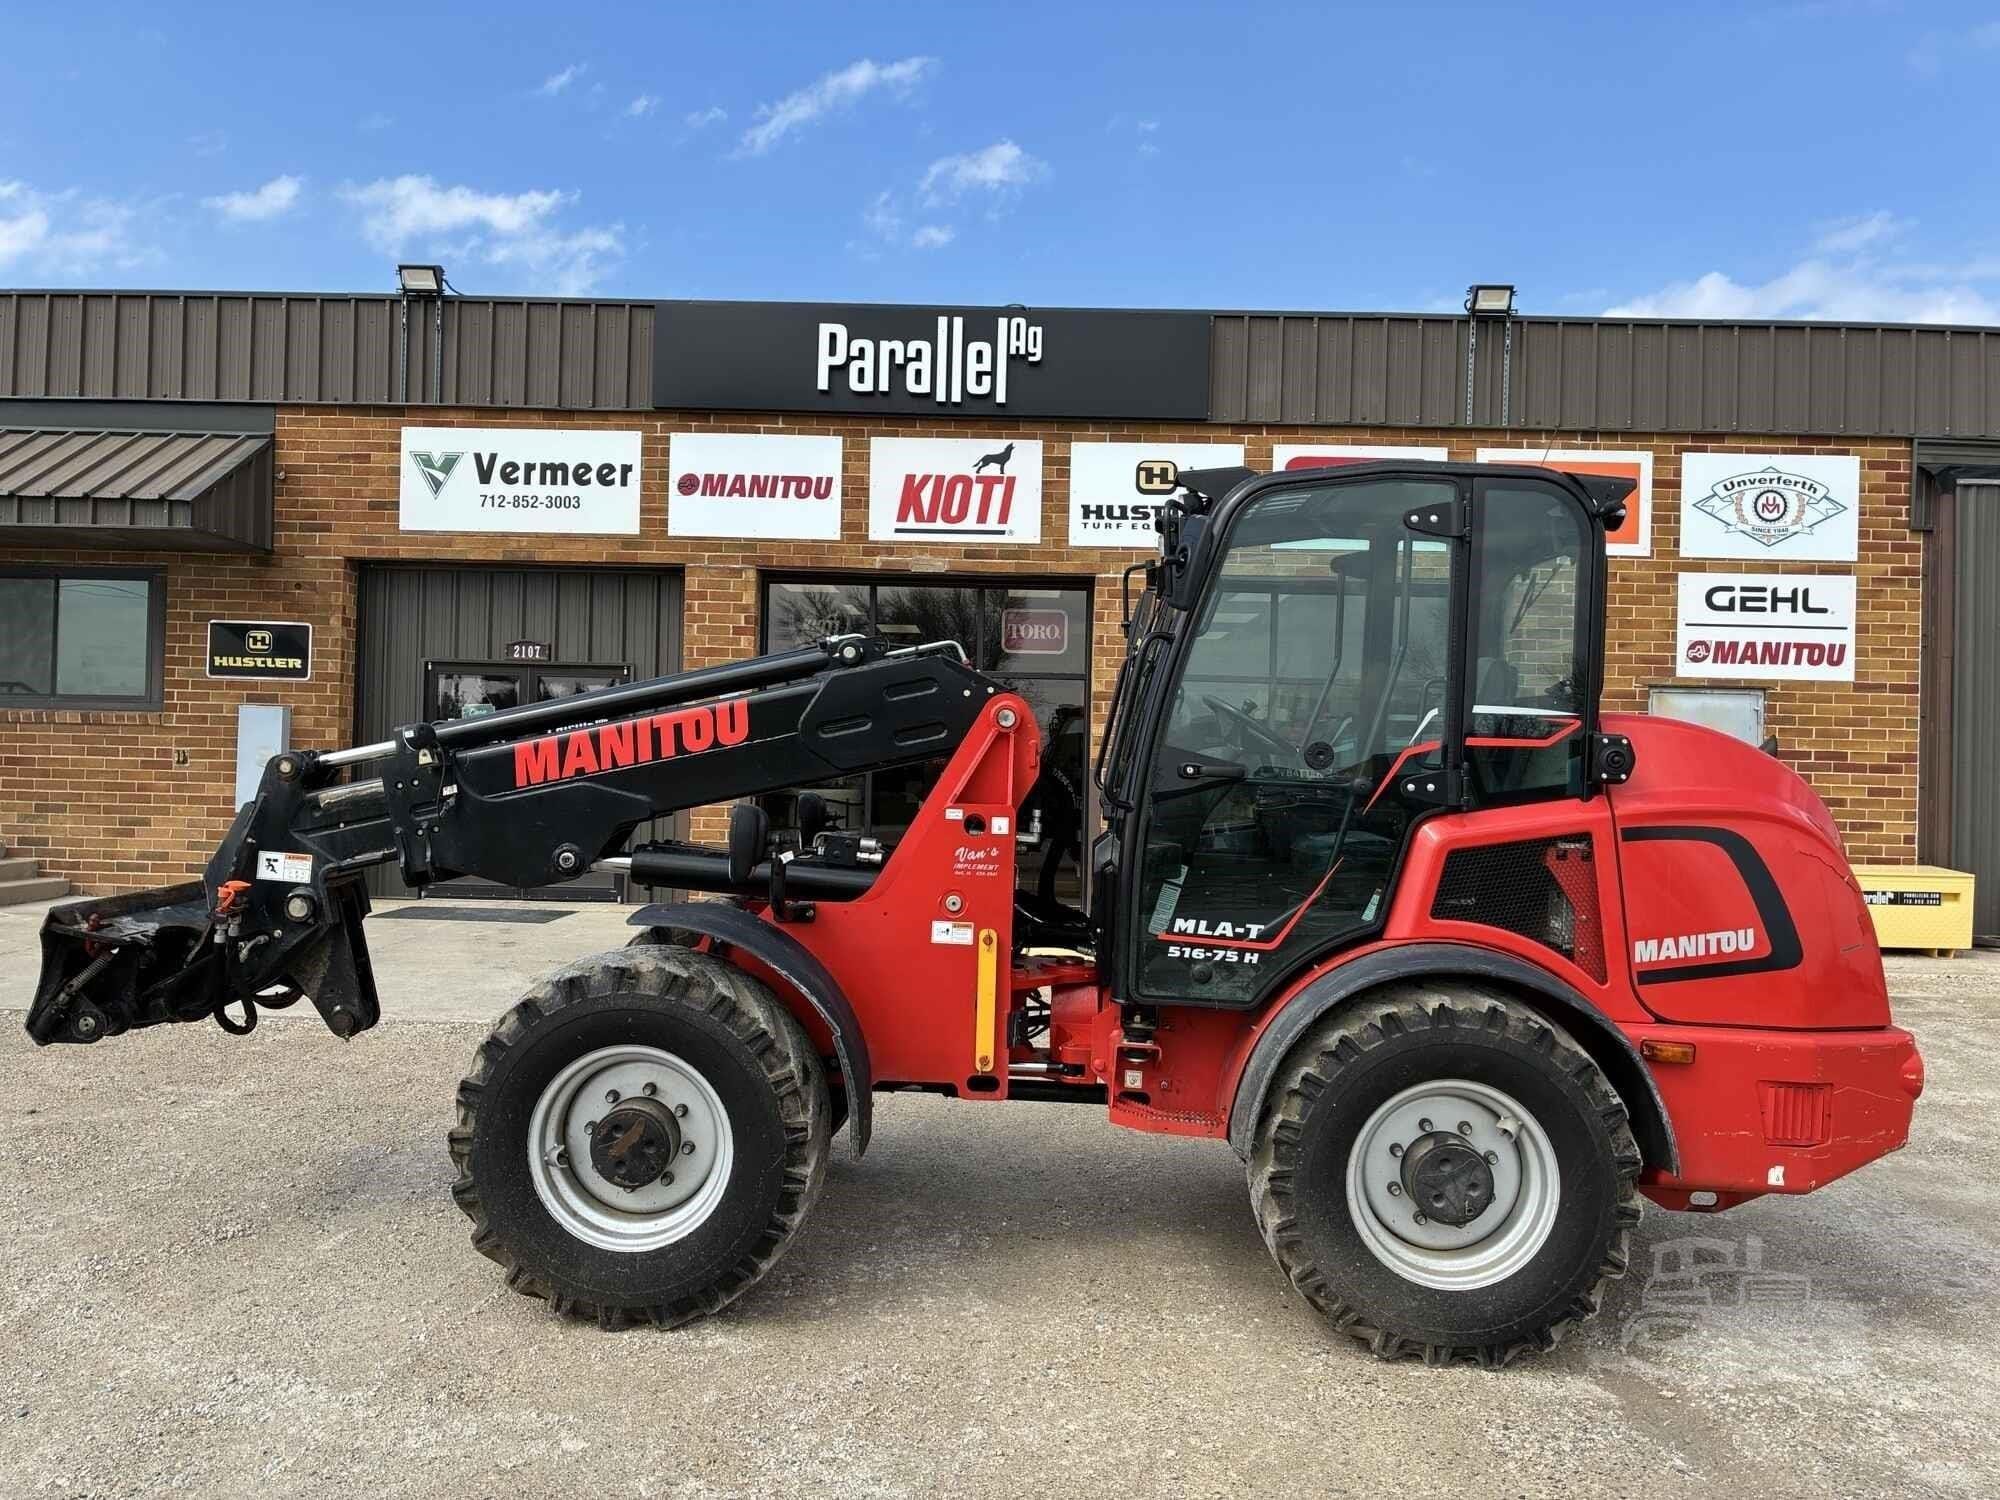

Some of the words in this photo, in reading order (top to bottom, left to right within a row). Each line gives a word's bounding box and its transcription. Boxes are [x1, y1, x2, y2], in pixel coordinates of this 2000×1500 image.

[817, 316, 1008, 403] Parallel
[473, 452, 633, 487] Vermeer
[700, 474, 833, 500] MANITOU
[1723, 476, 1818, 495] Unverferth
[479, 494, 581, 509] 712-852-3003
[896, 474, 1016, 524] KIOTI
[1081, 504, 1167, 520] HUST
[1081, 522, 1123, 530] TURF
[1705, 586, 1828, 613] GEHL
[1008, 623, 1061, 640] TORO
[513, 645, 541, 658] 2107
[1712, 641, 1846, 667] MANITOU
[213, 656, 302, 668] HUSTLER
[513, 699, 749, 787] MANITOU
[953, 863, 999, 871] IMPLEMENT
[1173, 918, 1264, 939] MLA-T
[1167, 946, 1239, 962] 516-75
[1243, 952, 1260, 964] H
[1634, 927, 1755, 963] MANITOU
